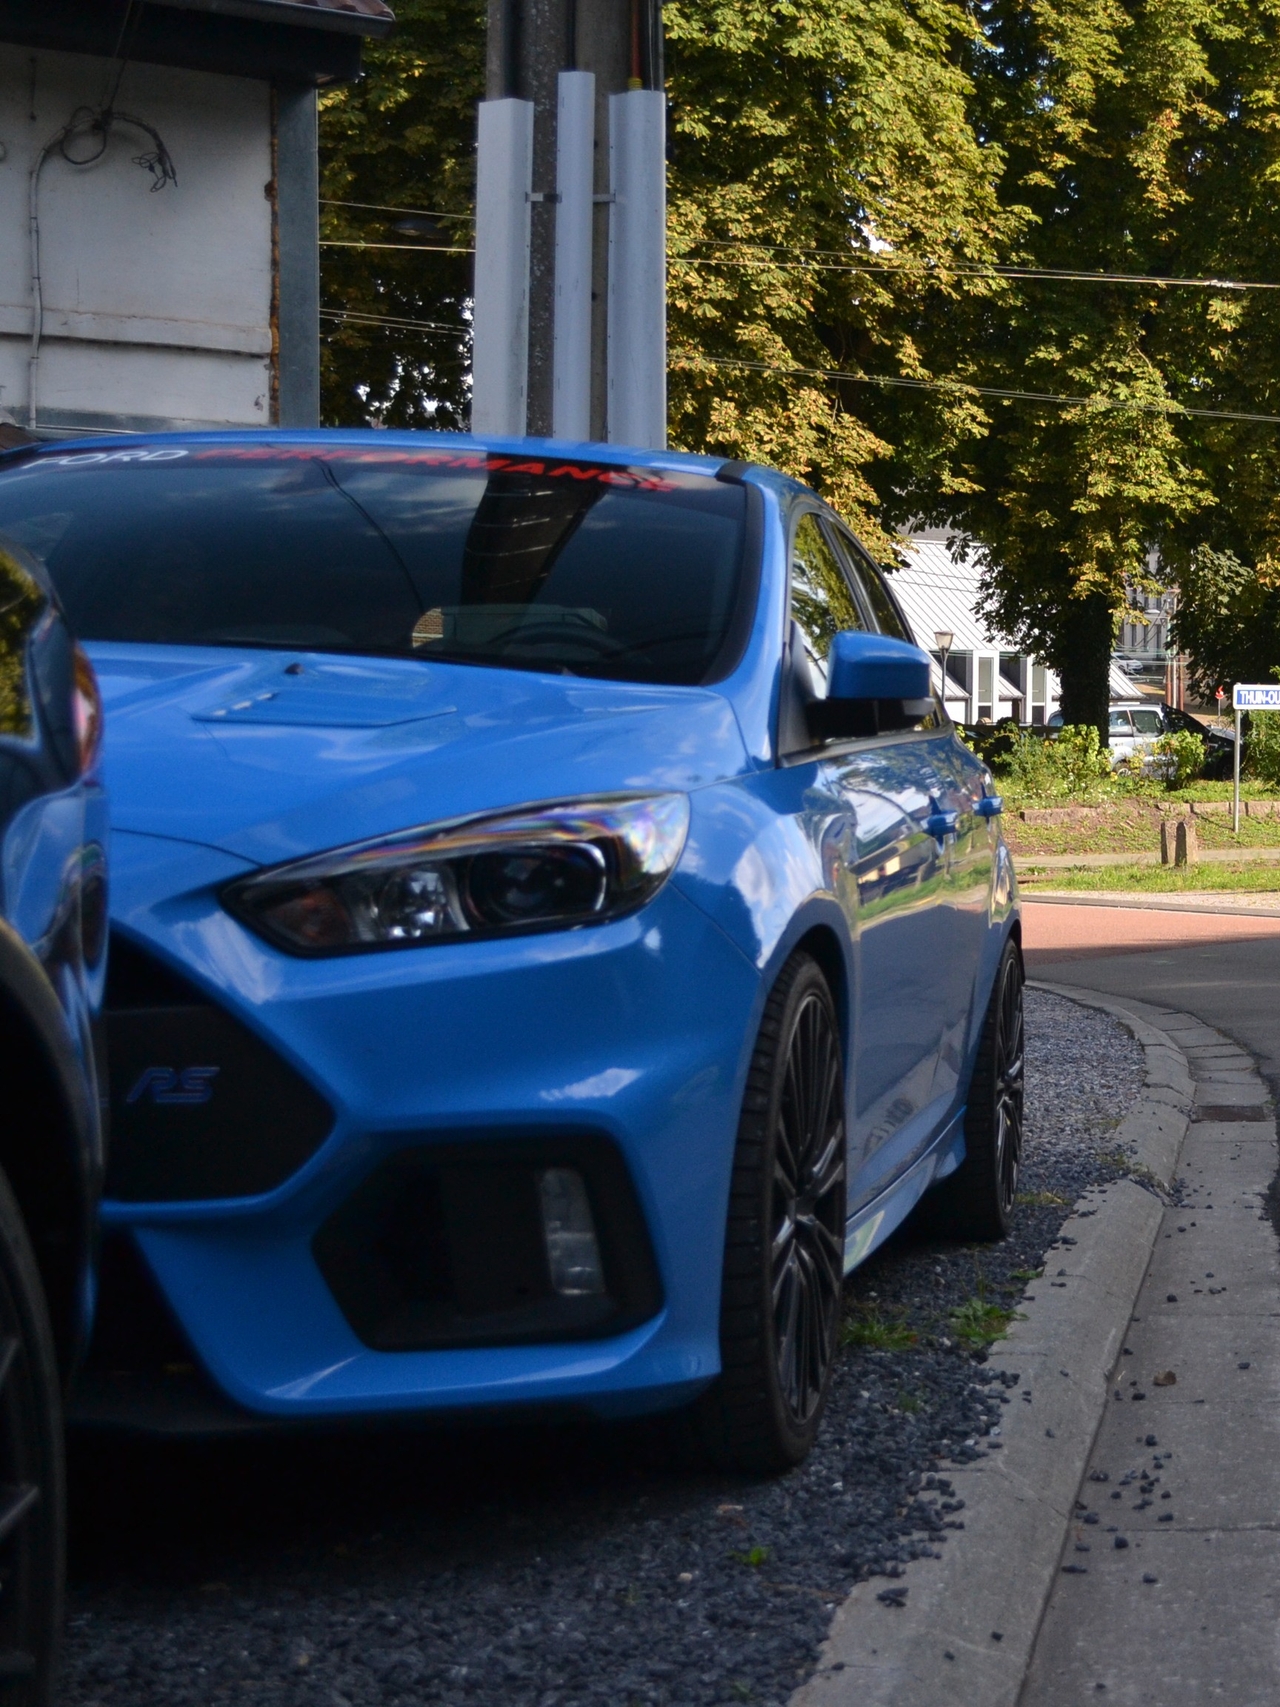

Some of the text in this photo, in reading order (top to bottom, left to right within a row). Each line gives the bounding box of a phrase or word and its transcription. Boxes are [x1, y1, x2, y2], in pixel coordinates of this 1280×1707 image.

[22, 448, 681, 492] FORD PERFORMANCE
[126, 1065, 220, 1103] RS
